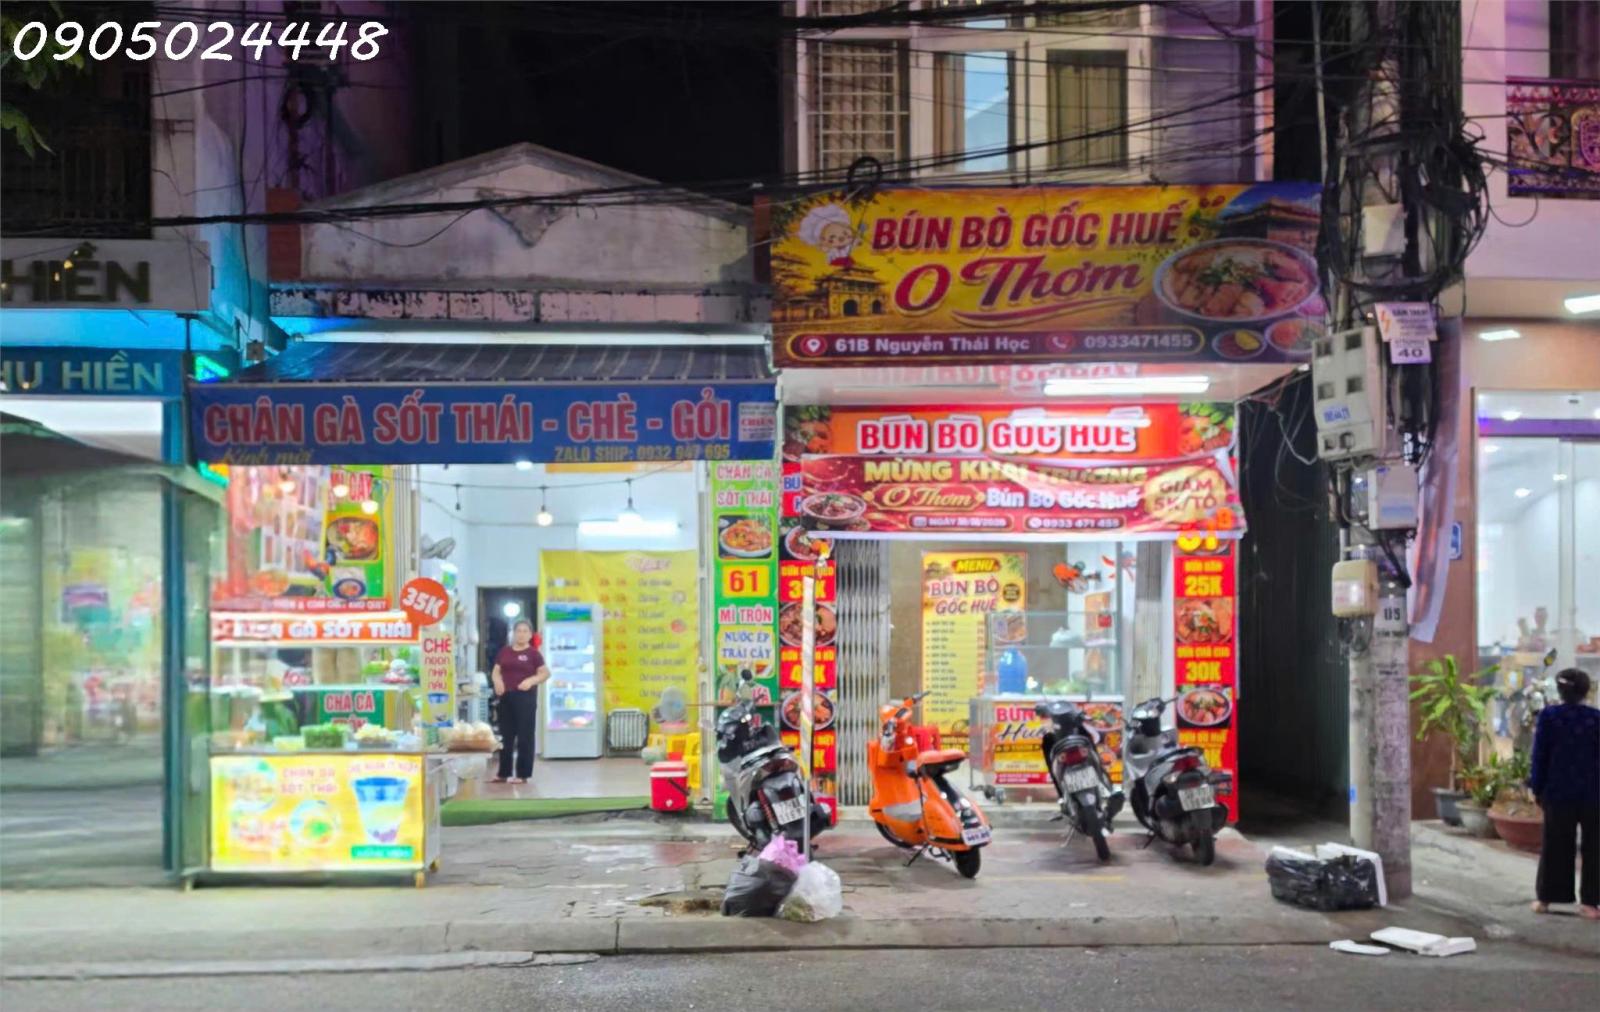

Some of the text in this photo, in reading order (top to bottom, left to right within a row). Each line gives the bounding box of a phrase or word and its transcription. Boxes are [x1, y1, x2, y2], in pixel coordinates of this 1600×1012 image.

[871, 199, 1188, 253] BÚN BÒ GỐC HUẾ
[892, 253, 1144, 316] O Thơm
[835, 336, 1030, 355] 61B Nguyễn Thái Học
[1084, 334, 1193, 349] 0933471455
[1397, 348, 1423, 358] 40
[62, 350, 163, 391] HIỀN
[204, 396, 304, 445] CHÂN
[314, 396, 365, 444] GÀ
[374, 389, 443, 443] SỐT
[451, 393, 533, 443] THÁI
[567, 392, 638, 442] CHÈ
[672, 387, 731, 442] GỎI
[555, 445, 590, 461] ZALO
[596, 445, 632, 461] SHIP:
[637, 444, 670, 460] 0932
[864, 457, 952, 482] MỪNG
[784, 474, 800, 491] BÚ
[986, 488, 1025, 507] Bún
[956, 560, 995, 573] MENU
[729, 570, 759, 592] 61
[788, 580, 826, 600] 3K
[930, 579, 969, 597] BÚN
[1184, 575, 1222, 597] 25K
[403, 586, 445, 618] 35K
[789, 664, 826, 684] 4K
[1185, 661, 1222, 682] 30K
